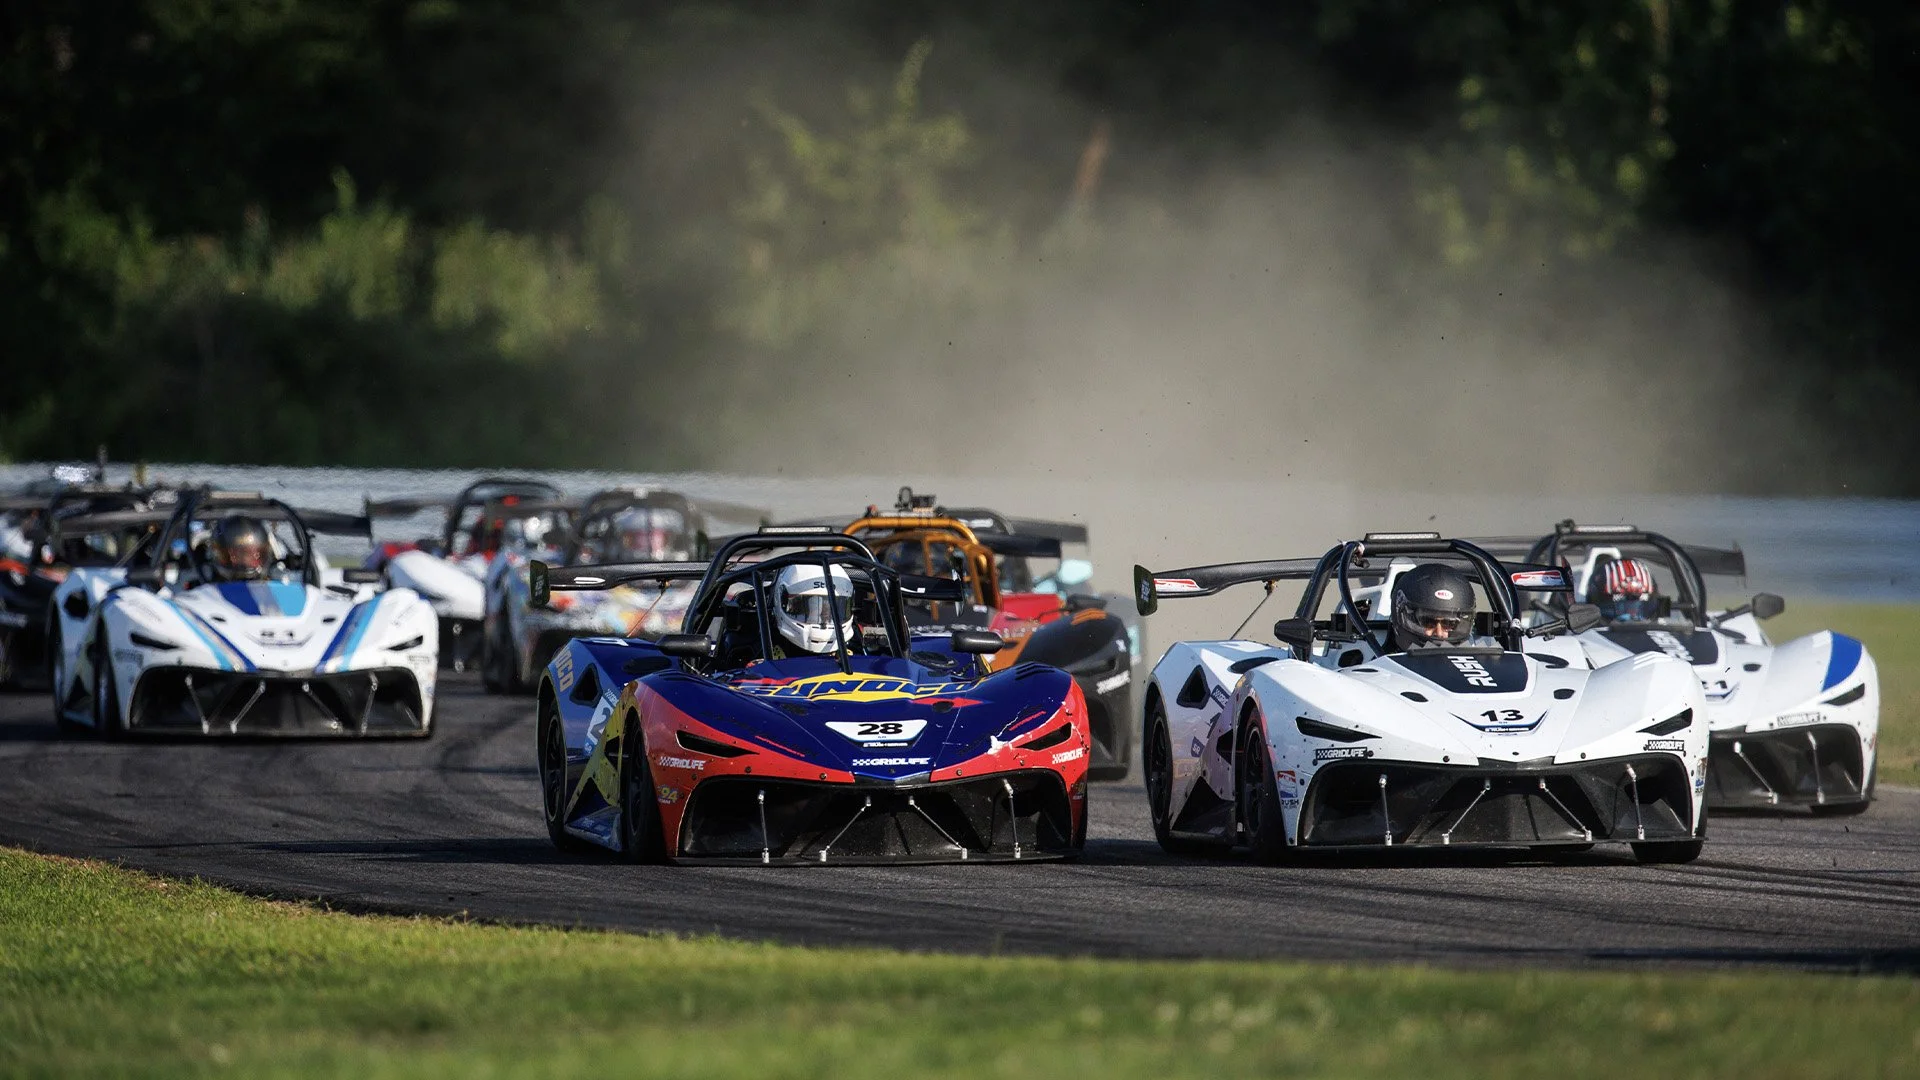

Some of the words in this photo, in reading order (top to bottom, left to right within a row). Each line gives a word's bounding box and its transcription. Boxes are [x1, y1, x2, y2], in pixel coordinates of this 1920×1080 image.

[1447, 656, 1497, 687] RUSH
[737, 679, 976, 699] SUNOCO
[1480, 709, 1524, 722] 13
[857, 723, 903, 735] 28
[1327, 748, 1366, 758] GRIDLIFE
[671, 757, 706, 770] GRIDLIFE
[870, 758, 930, 766] GRIDLIFE
